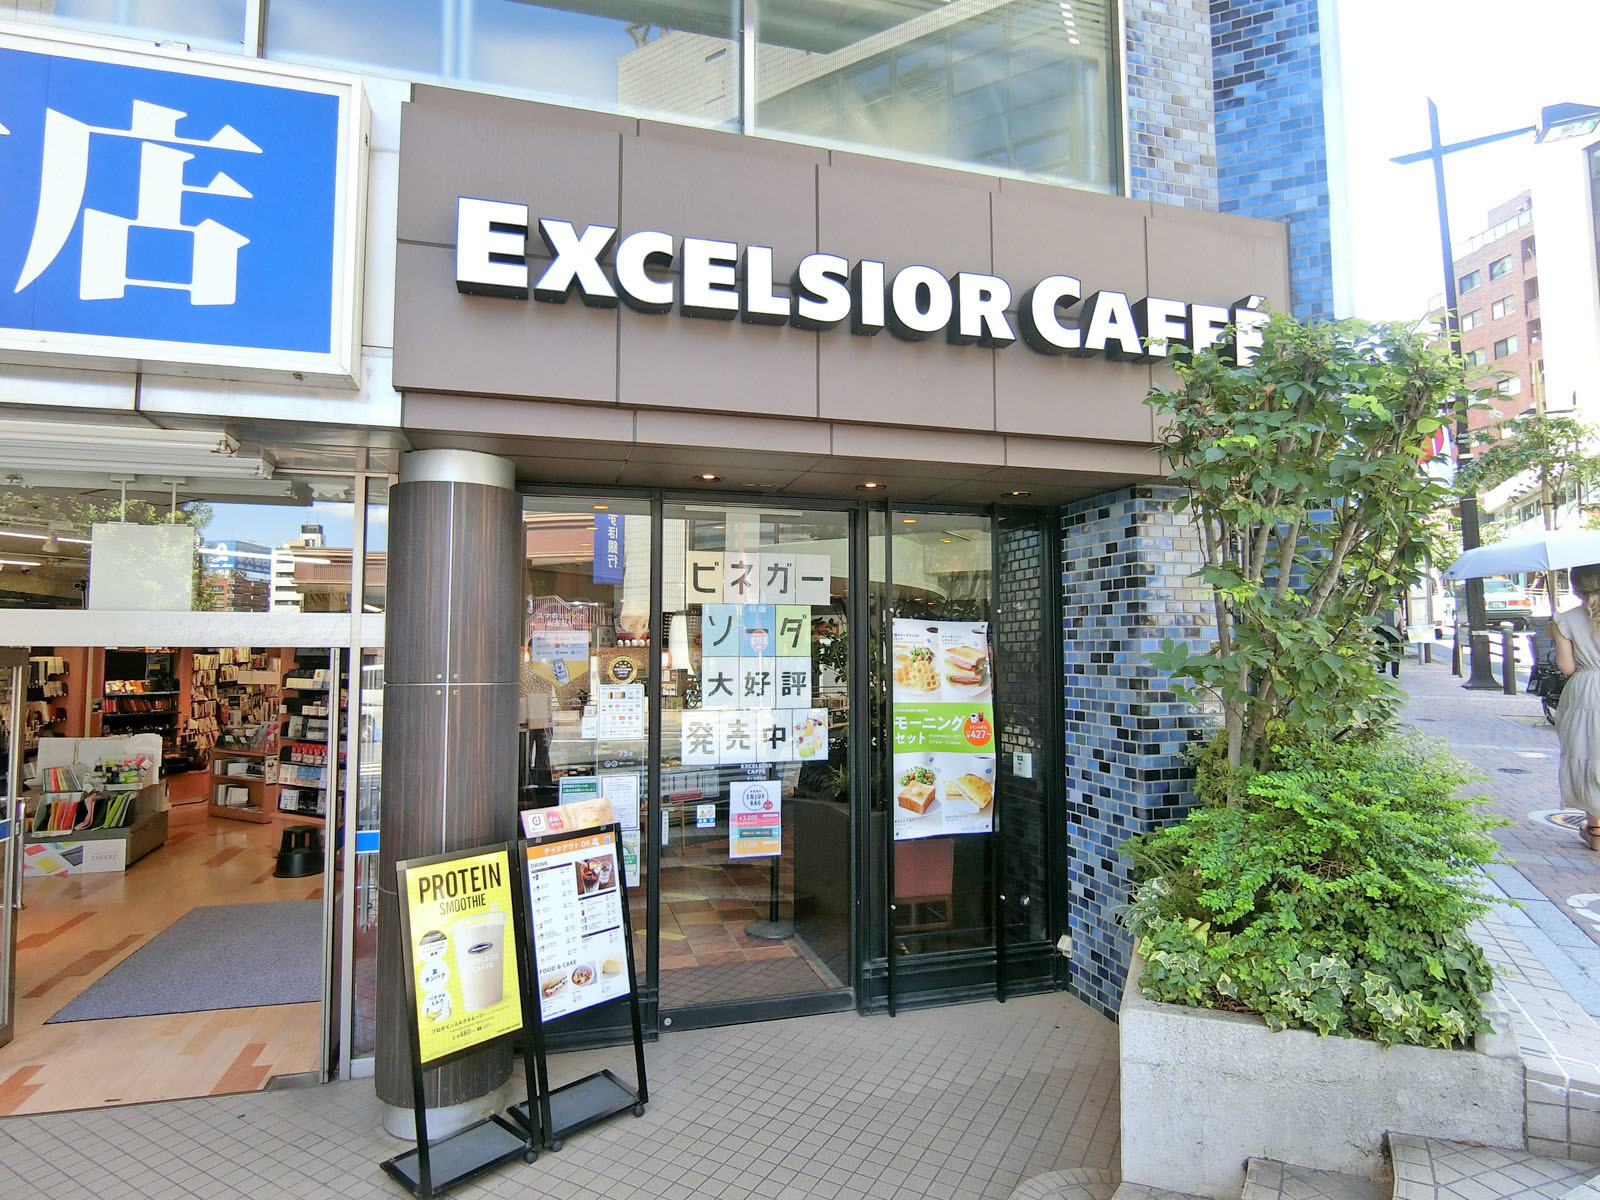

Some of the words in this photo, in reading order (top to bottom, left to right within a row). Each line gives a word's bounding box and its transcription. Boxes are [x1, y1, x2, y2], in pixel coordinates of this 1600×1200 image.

[0, 99, 263, 306] 店
[455, 196, 1016, 344] EXCELSIOR
[692, 561, 824, 595] ビネガー
[708, 614, 807, 649] ソーダ
[708, 671, 807, 697] 大好評
[894, 715, 965, 732] モーニング
[686, 719, 786, 755] 発売中
[895, 731, 925, 745] セット
[544, 843, 579, 855] テイクアウト
[581, 840, 591, 848] OK
[531, 861, 548, 869] DRINK
[419, 862, 502, 904] PROTEIN
[440, 896, 487, 916] SMOOTHIE
[539, 965, 556, 974] FOOD
[563, 959, 577, 968] CAKE
